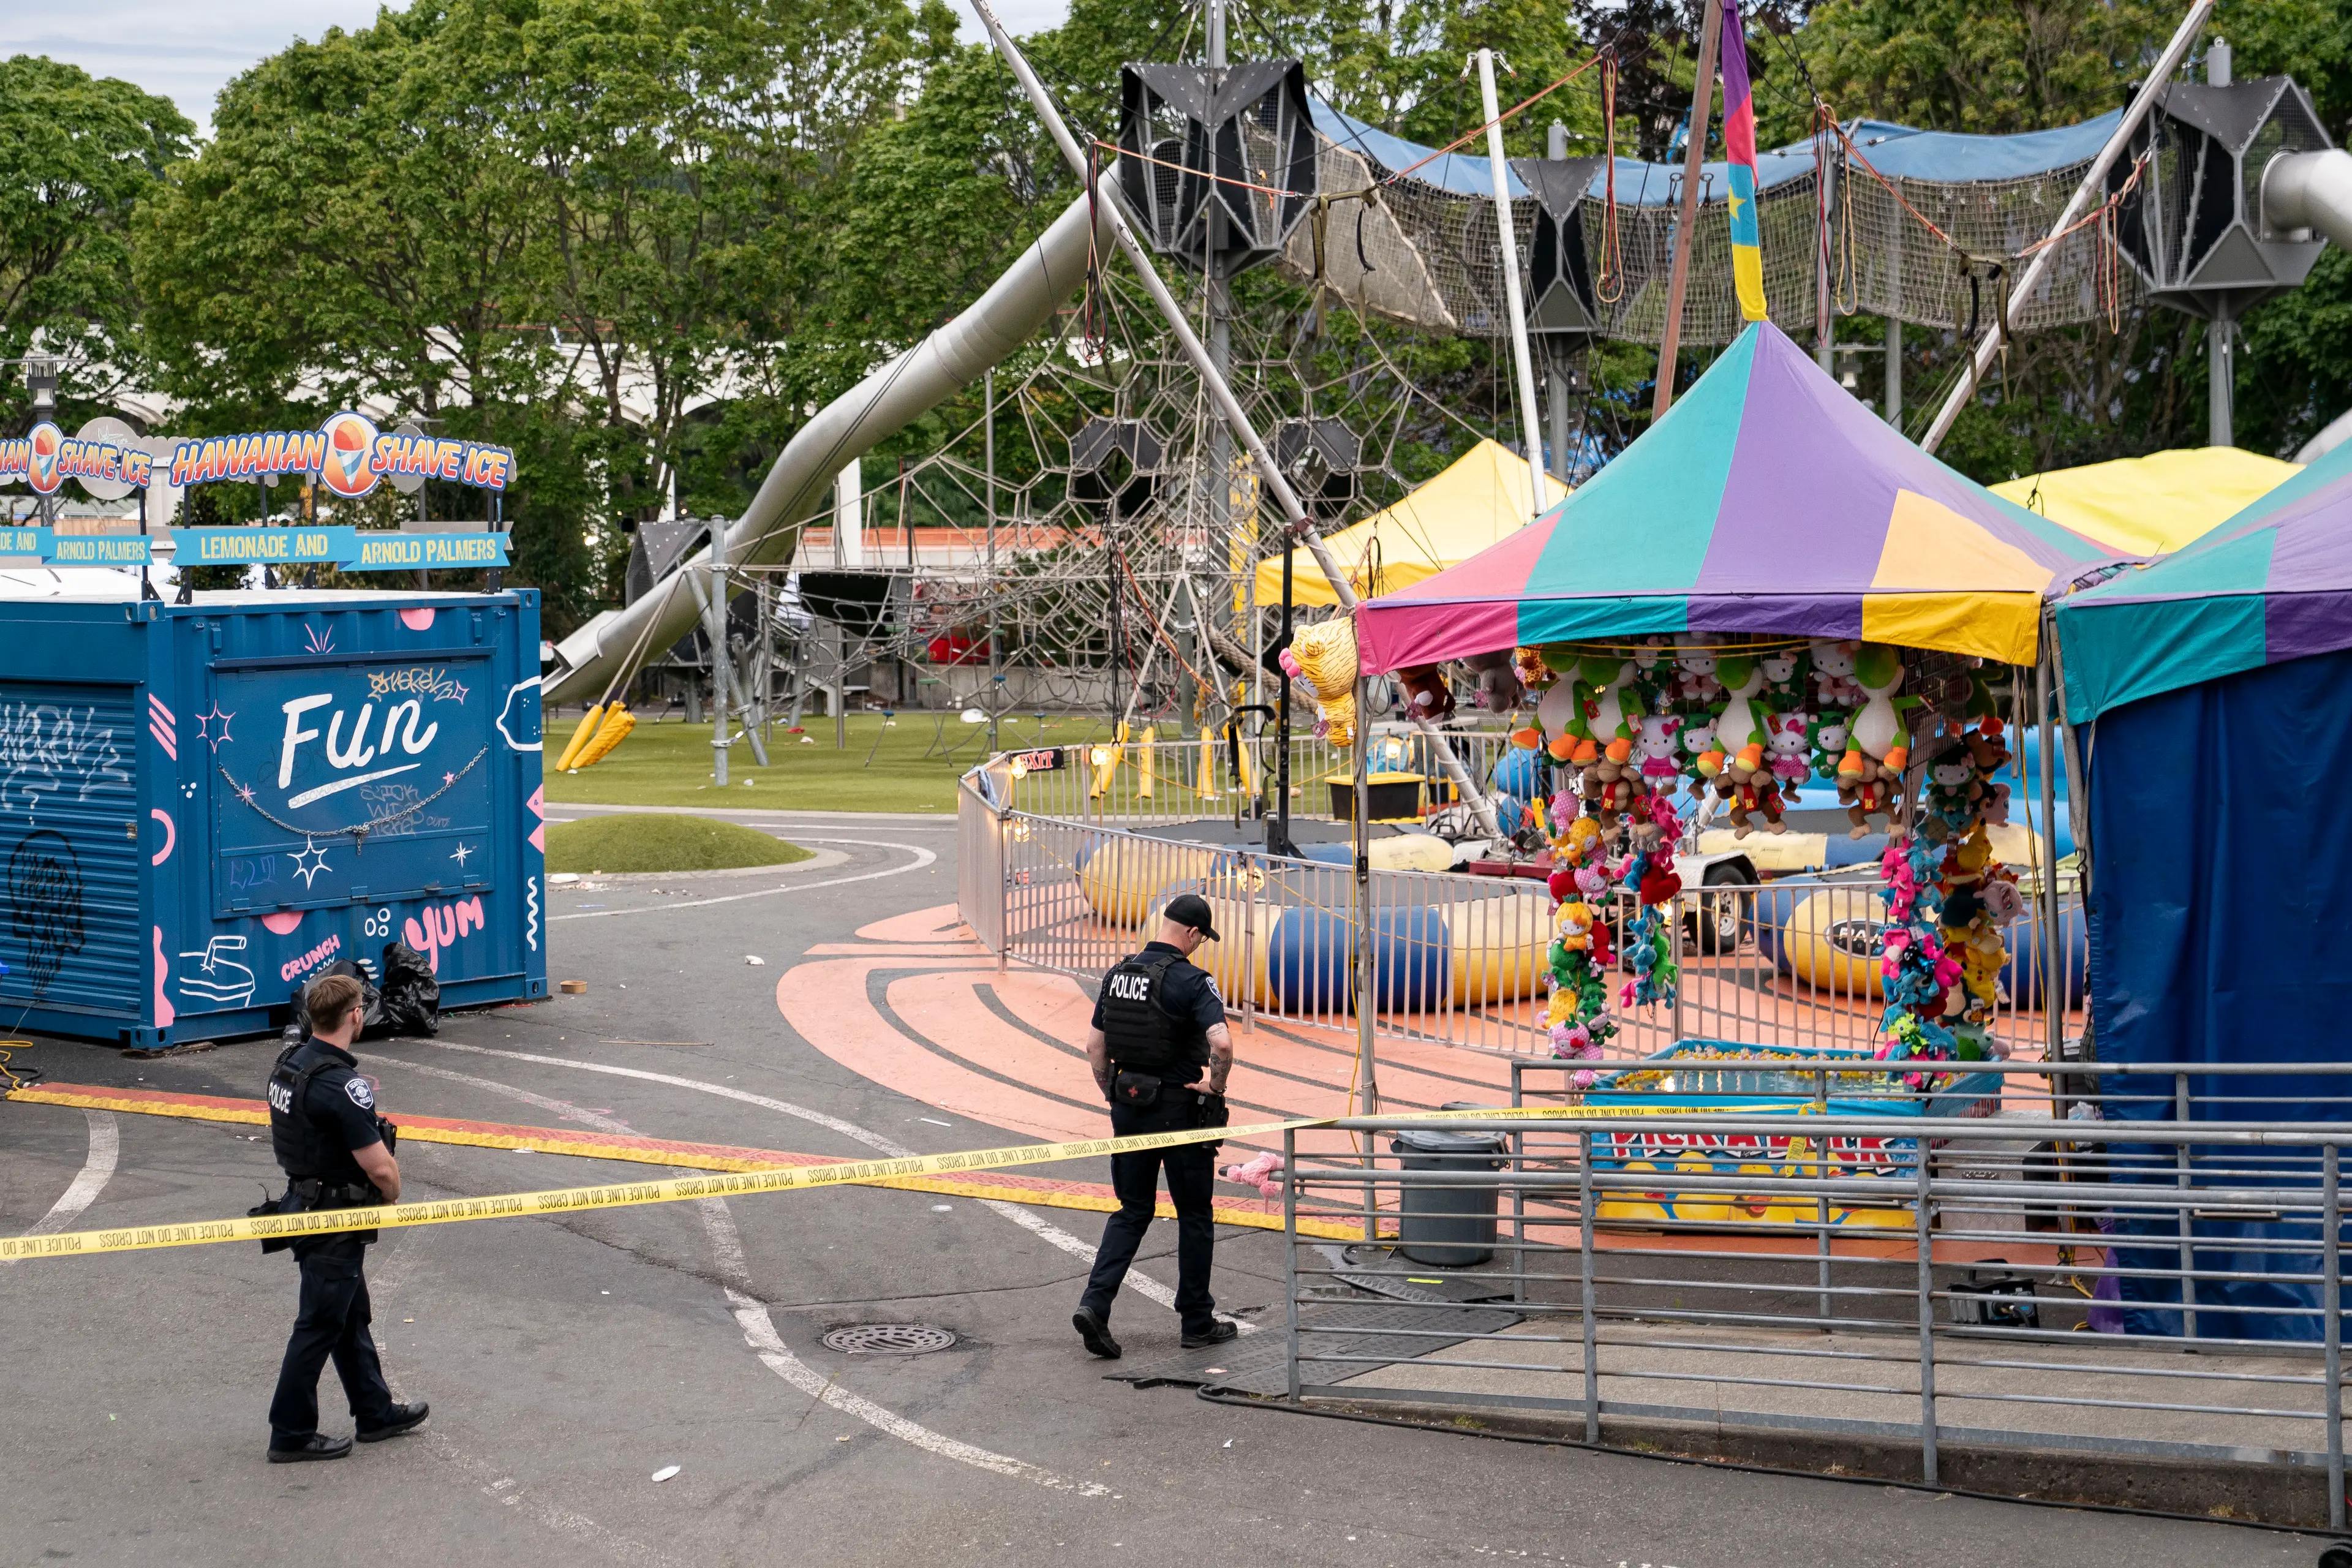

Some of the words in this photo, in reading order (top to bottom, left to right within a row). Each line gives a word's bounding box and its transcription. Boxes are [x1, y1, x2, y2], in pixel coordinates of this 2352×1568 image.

[58, 442, 118, 479] SHAVE
[120, 450, 151, 486] ICE
[172, 432, 326, 485] HAWAIIAN
[372, 435, 461, 477] SHAVE
[464, 445, 509, 488] ICE
[17, 532, 37, 551] AND
[202, 535, 288, 559] LEMONADE
[295, 534, 328, 556] AND
[56, 541, 94, 560] ARNOLD
[98, 541, 146, 560] PALMERS
[361, 541, 421, 564] ARNOLD
[426, 539, 496, 561] PALMERS
[278, 693, 438, 789] Fun
[1019, 751, 1054, 770] EXIT
[405, 895, 484, 974] YUM
[281, 935, 341, 982] CRUNCH
[1109, 974, 1150, 1001] POLICE
[268, 1082, 292, 1114] POLICE
[1186, 1131, 1216, 1140] CROSS
[1218, 1128, 1234, 1137] NOT
[1093, 1140, 1109, 1152] NOT
[1111, 1139, 1125, 1150] DO
[1126, 1137, 1144, 1148] LINE
[1146, 1135, 1175, 1147] POLICE
[1001, 1150, 1019, 1163] LINE
[1020, 1147, 1051, 1160] POLICE
[1063, 1142, 1092, 1156] CROSS
[937, 1155, 966, 1170] CROSS
[968, 1153, 985, 1167] NOT
[987, 1152, 999, 1164] DO
[840, 1166, 856, 1180] NOT
[858, 1164, 870, 1177] DO
[872, 1163, 891, 1177] LINE
[894, 1159, 924, 1174] POLICE
[742, 1175, 760, 1189] LINE
[763, 1172, 794, 1187] POLICE
[807, 1168, 837, 1183] CROSS
[675, 1180, 704, 1196] CROSS
[707, 1178, 725, 1193] NOT
[726, 1177, 739, 1191] DO
[571, 1191, 589, 1206] NOT
[591, 1190, 603, 1204] DO
[606, 1188, 625, 1203] LINE
[628, 1185, 660, 1200] POLICE
[467, 1201, 487, 1216] LINE
[489, 1198, 522, 1214] POLICE
[538, 1194, 568, 1210] CROSS
[397, 1207, 428, 1222] CROSS
[431, 1204, 449, 1219] NOT
[451, 1203, 464, 1217] DO
[286, 1216, 304, 1232] NOT
[307, 1215, 320, 1230] DO
[323, 1213, 344, 1229] LINE
[347, 1210, 380, 1227] POLICE
[175, 1227, 195, 1241] LINE
[200, 1224, 233, 1239] POLICE
[251, 1219, 282, 1235] CROSS
[99, 1232, 132, 1248] CROSS
[136, 1230, 154, 1245] NOT
[158, 1229, 171, 1243] DO
[2, 1242, 17, 1255] DO
[20, 1240, 42, 1254] LINE
[45, 1237, 81, 1252] POLICE
